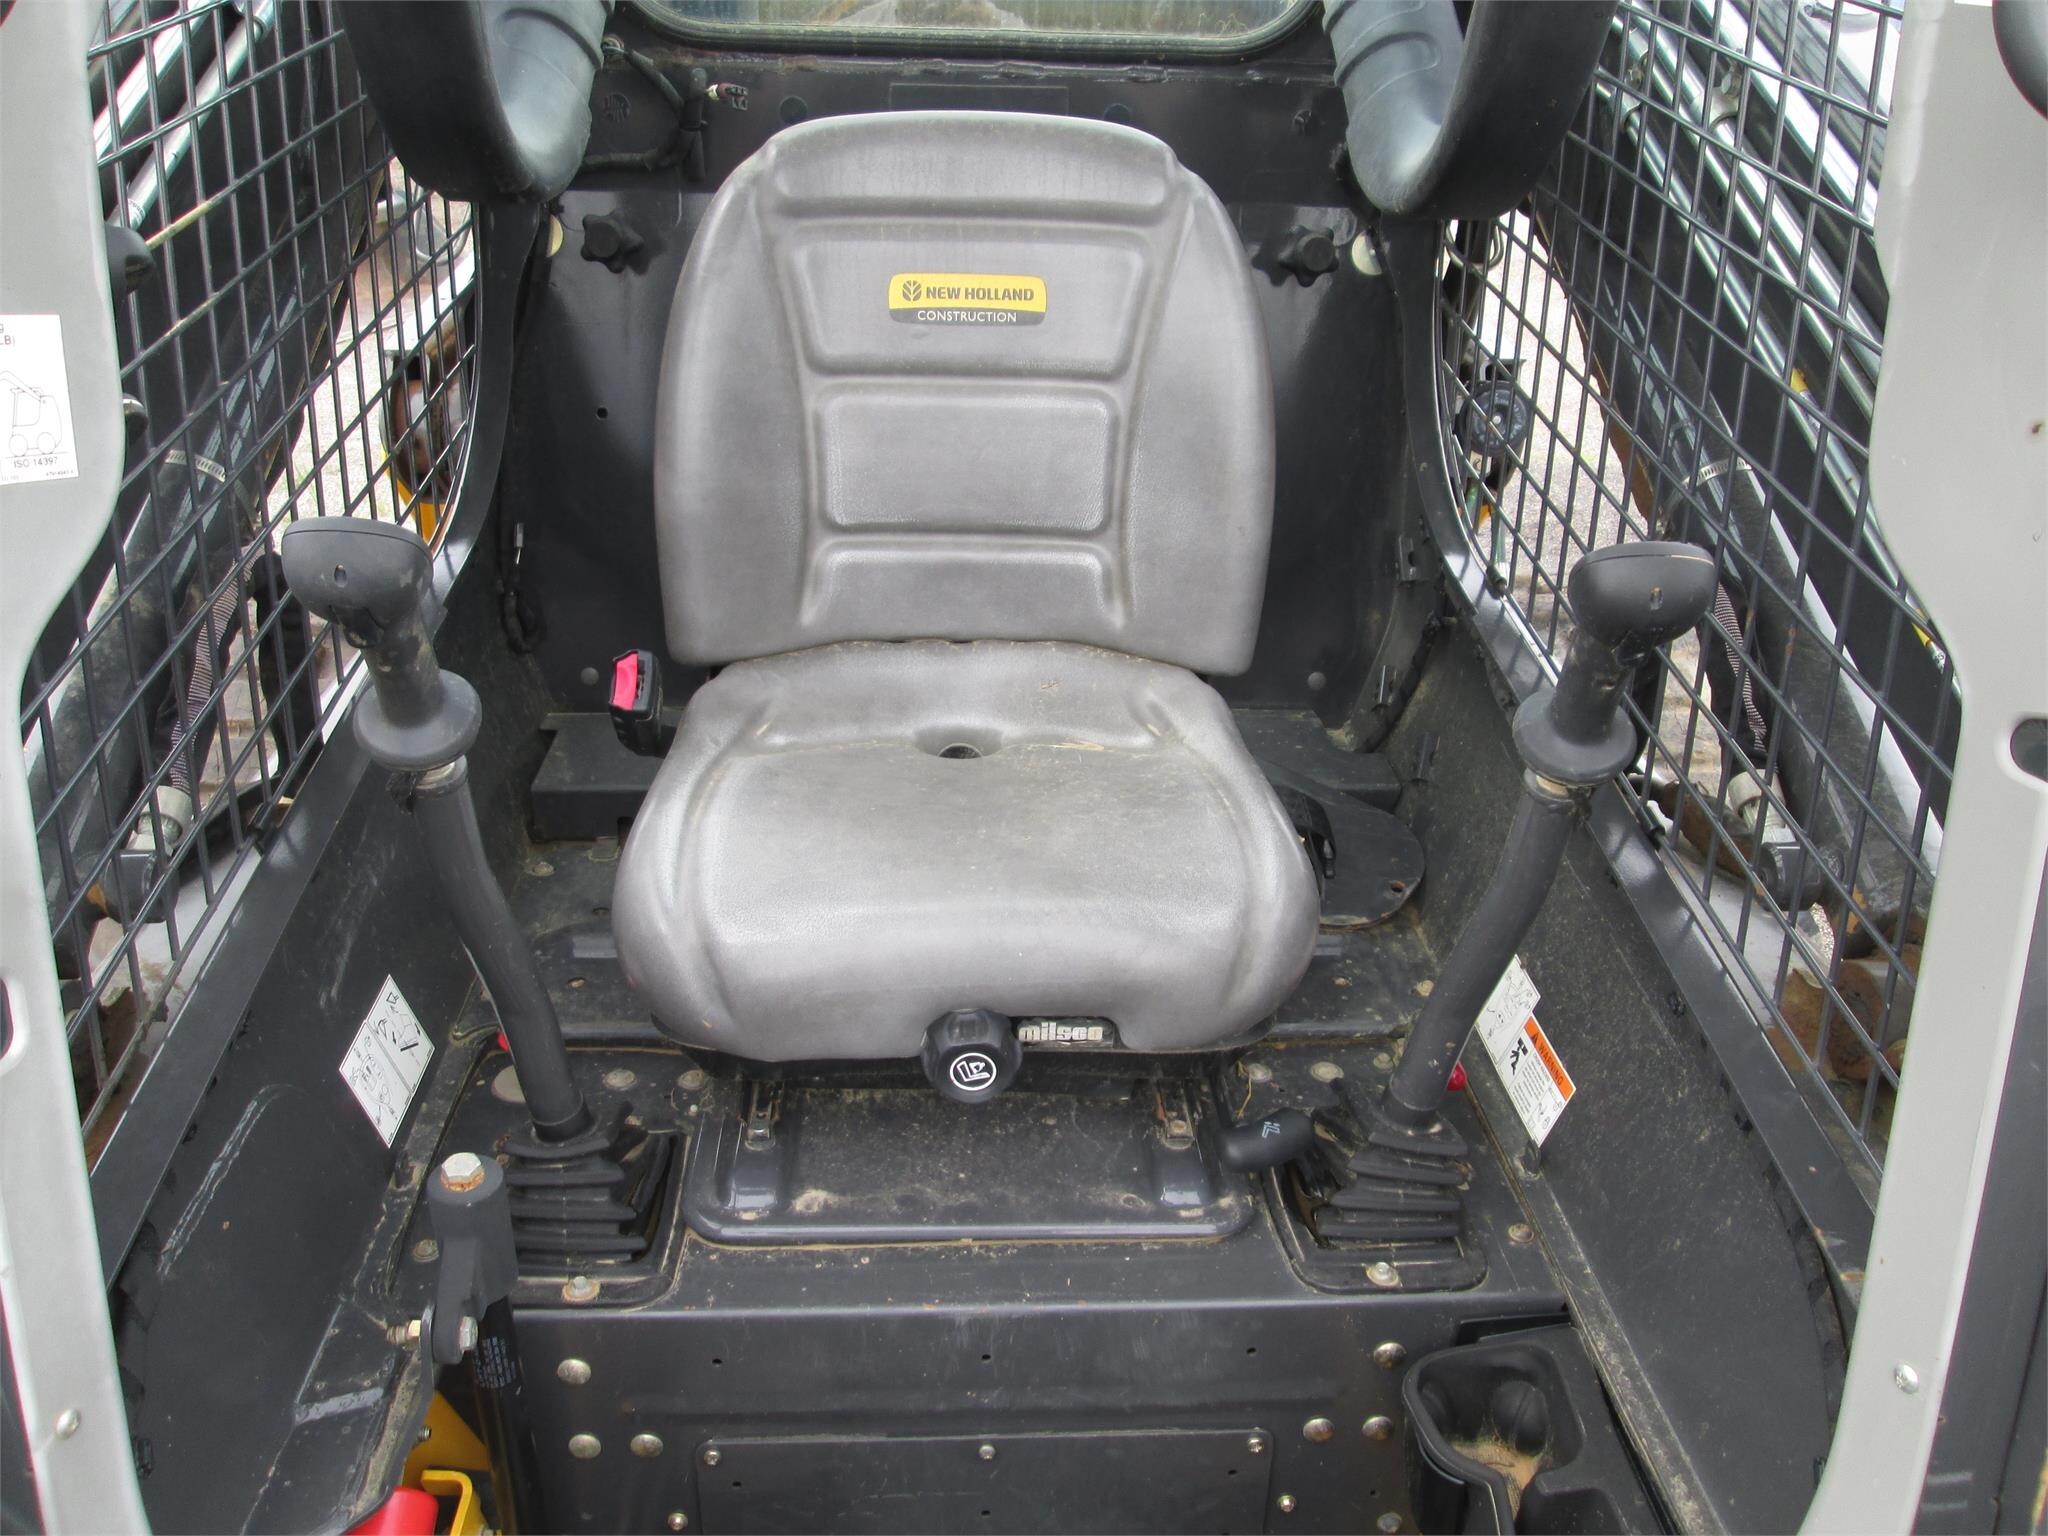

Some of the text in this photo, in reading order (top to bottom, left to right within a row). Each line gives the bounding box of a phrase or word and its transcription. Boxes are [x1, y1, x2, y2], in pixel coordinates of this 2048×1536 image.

[926, 286, 1034, 301] NEW HOLLAND
[917, 310, 1017, 323] CONSTRUCTION
[13, 456, 58, 468] ISO 14397
[1018, 1022, 1103, 1041] milsco
[1538, 1042, 1564, 1086] WARNING
